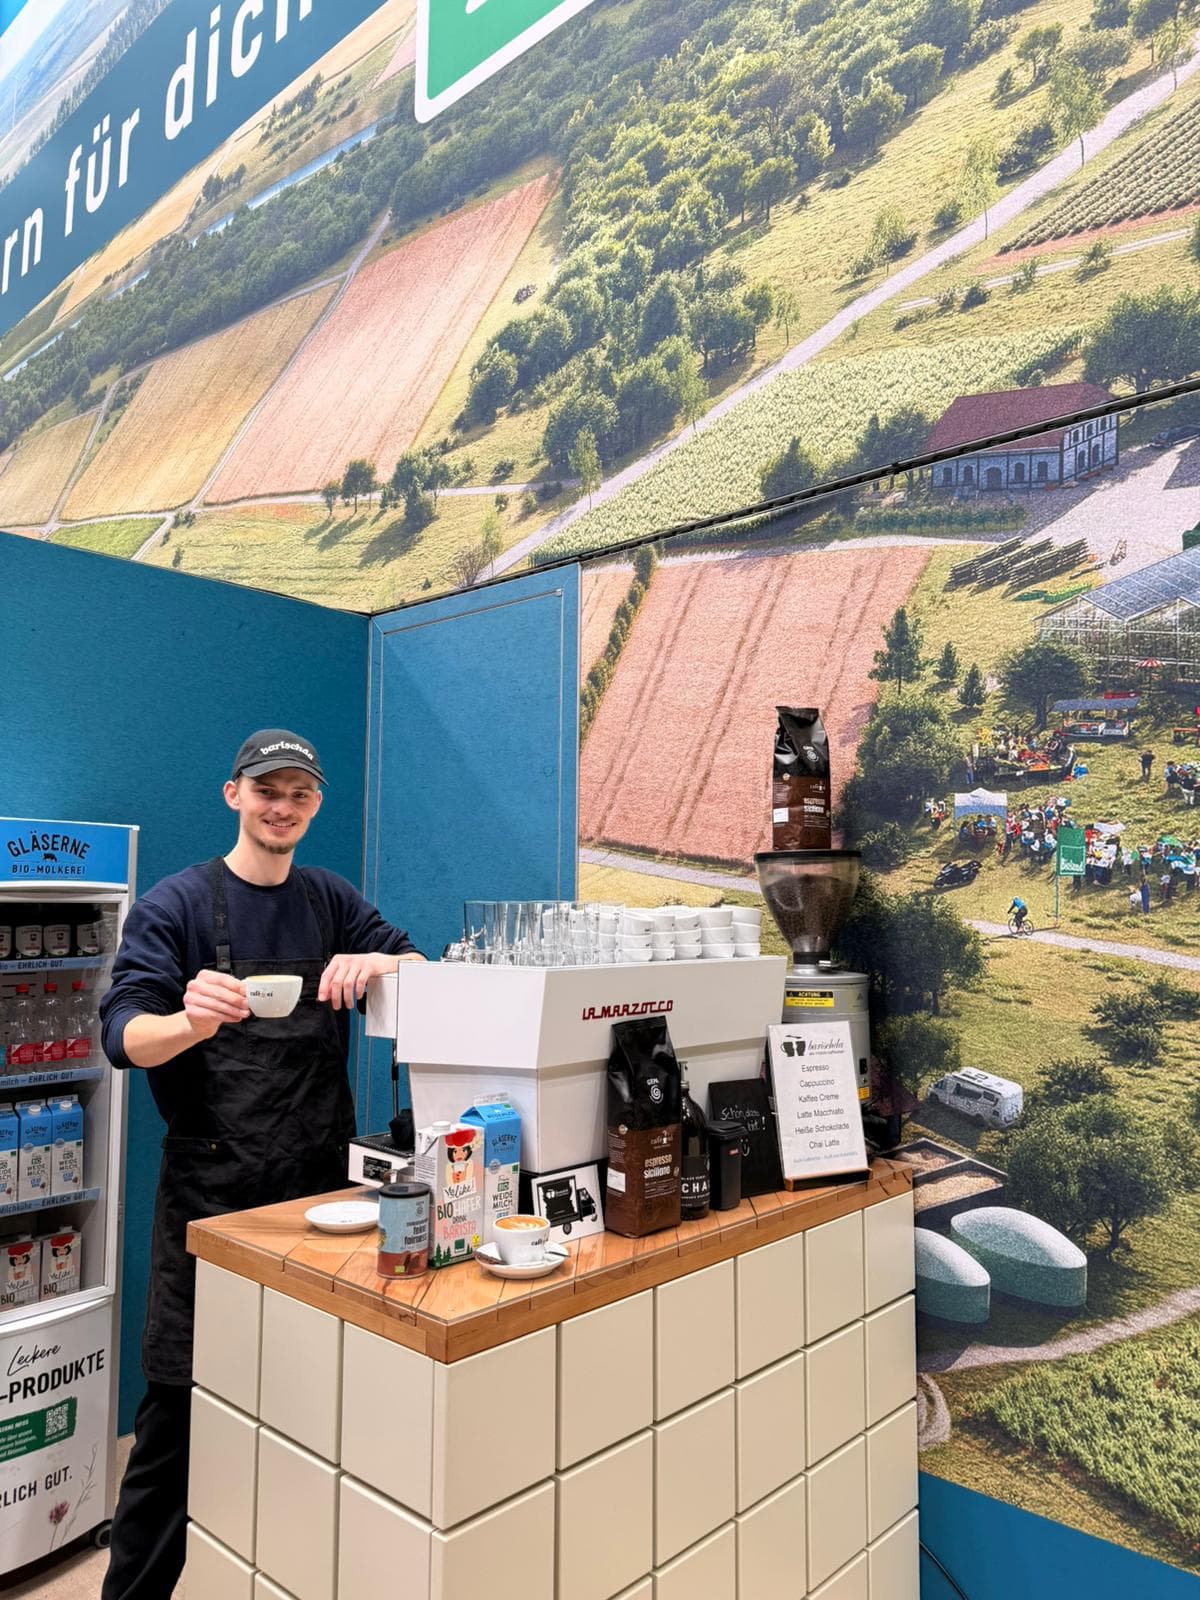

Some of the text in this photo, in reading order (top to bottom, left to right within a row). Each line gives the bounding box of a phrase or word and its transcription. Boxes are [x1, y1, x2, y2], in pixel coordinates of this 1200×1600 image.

[64, 107, 141, 238] für
[7, 830, 90, 860] GLÄSERNE
[12, 864, 85, 875] BIO-MOLKEREI
[17, 961, 47, 970] EHRLICH
[582, 1000, 673, 1020] LA MARZOCCO
[801, 1064, 830, 1073] Espresso
[29, 1073, 58, 1083] EHRLICH
[799, 1079, 835, 1088] Cappuccino
[798, 1095, 818, 1103] Kaffee
[797, 1107, 844, 1119] Latte Macchiato
[795, 1122, 850, 1135] Heiße Schokolade
[808, 1139, 840, 1149] Chai Latte
[644, 1153, 673, 1168] espresso
[41, 1195, 71, 1207] EHRLICH
[492, 1190, 513, 1202] WEIDE
[492, 1199, 513, 1210] MILCH
[436, 1202, 453, 1221] BIO
[452, 1214, 468, 1224] DRINK
[43, 1282, 57, 1296] BIO
[0, 1292, 15, 1306] BIO
[7, 1344, 62, 1376] Leckere
[45, 1465, 72, 1491] GUT.
